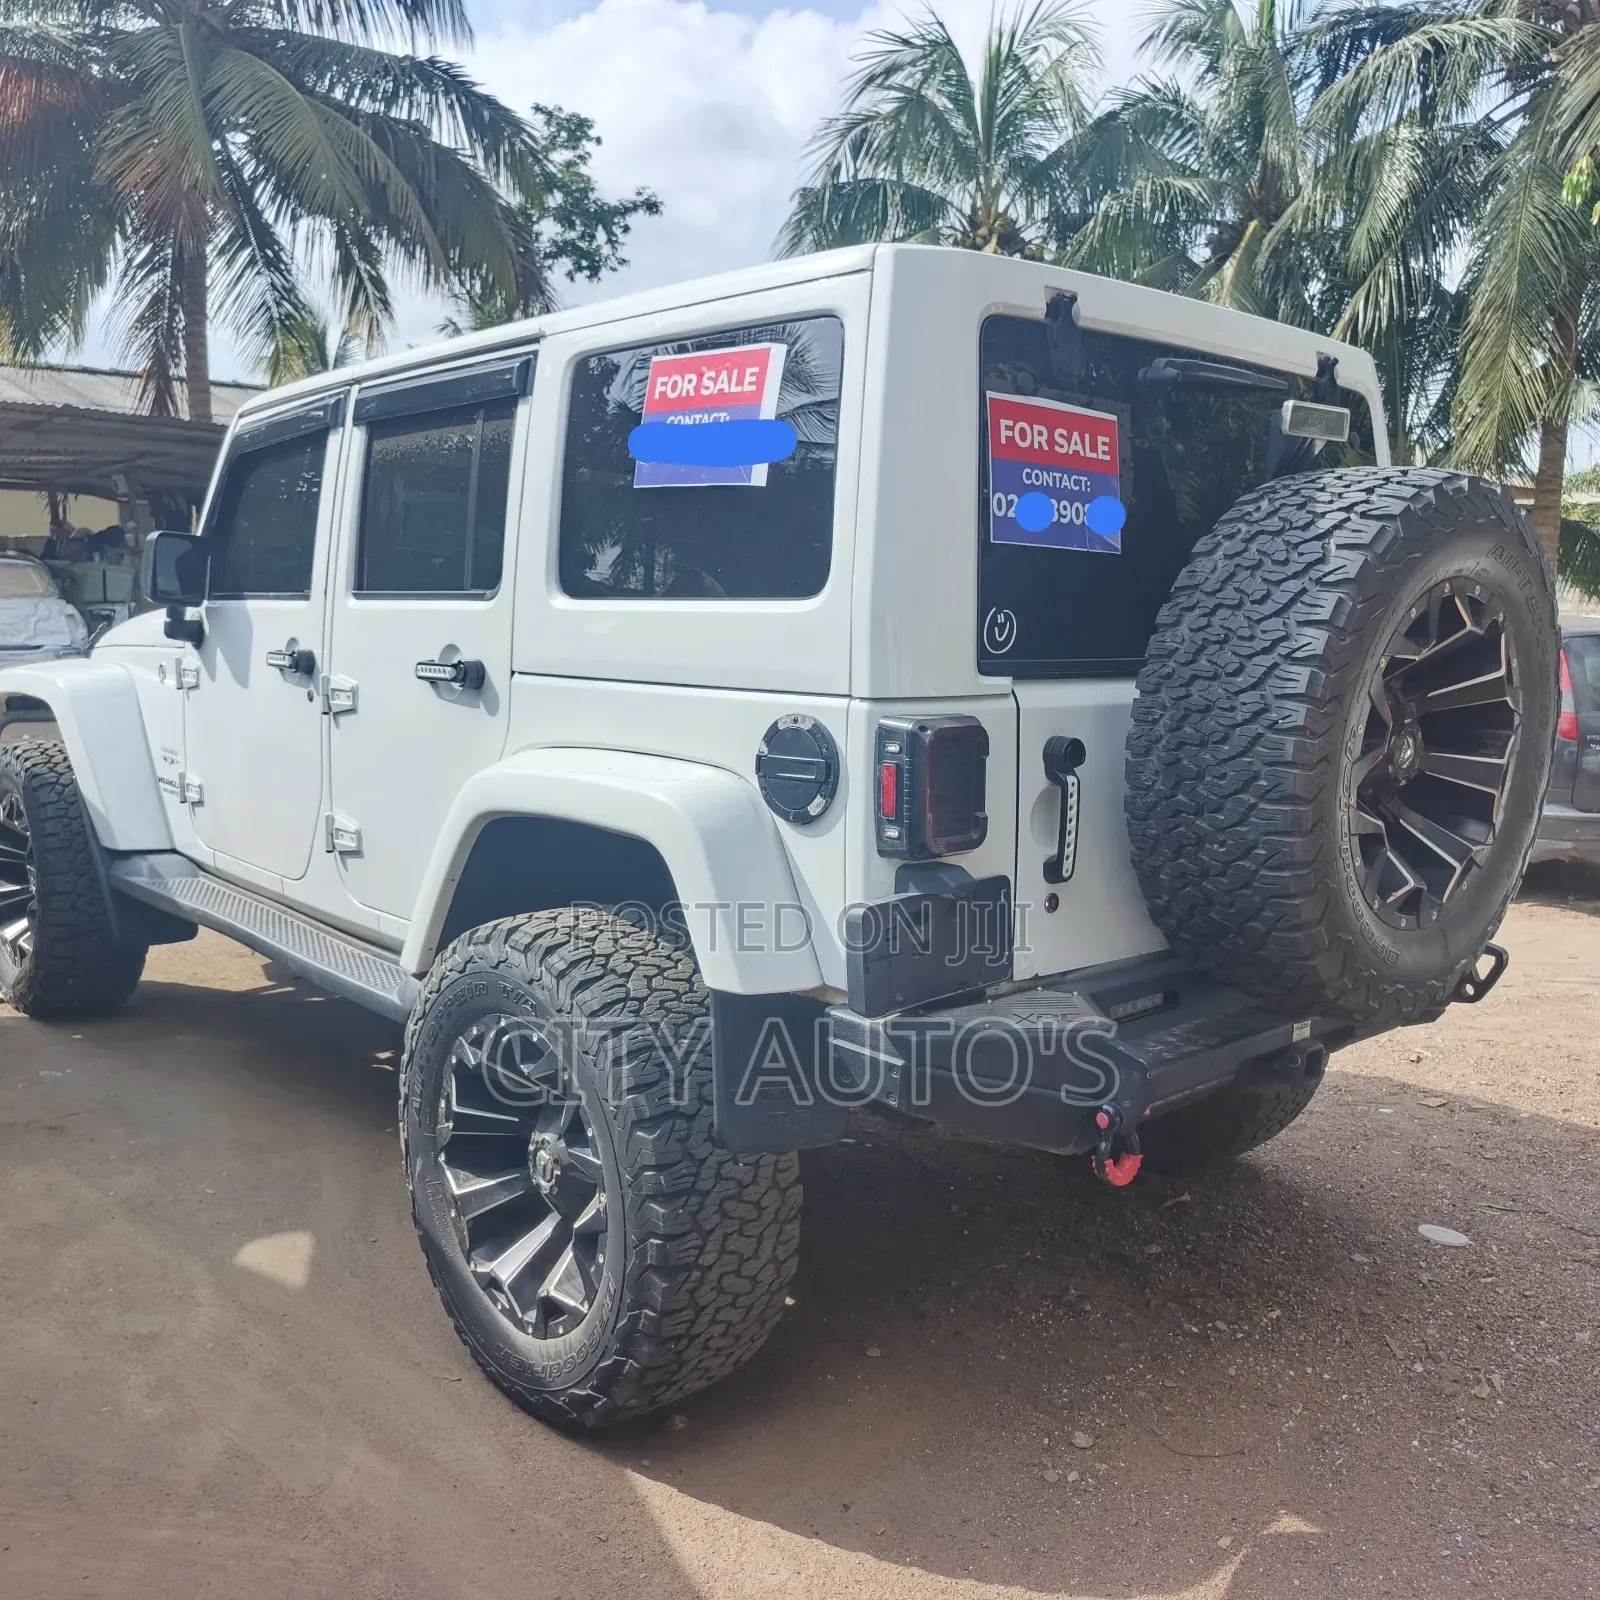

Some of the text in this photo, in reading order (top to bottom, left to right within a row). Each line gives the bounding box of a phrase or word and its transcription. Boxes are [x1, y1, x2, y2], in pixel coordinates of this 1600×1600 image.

[654, 366, 760, 400] FOR SALE
[999, 418, 1111, 461] FOR SALE
[1022, 467, 1091, 492] CONTACT:
